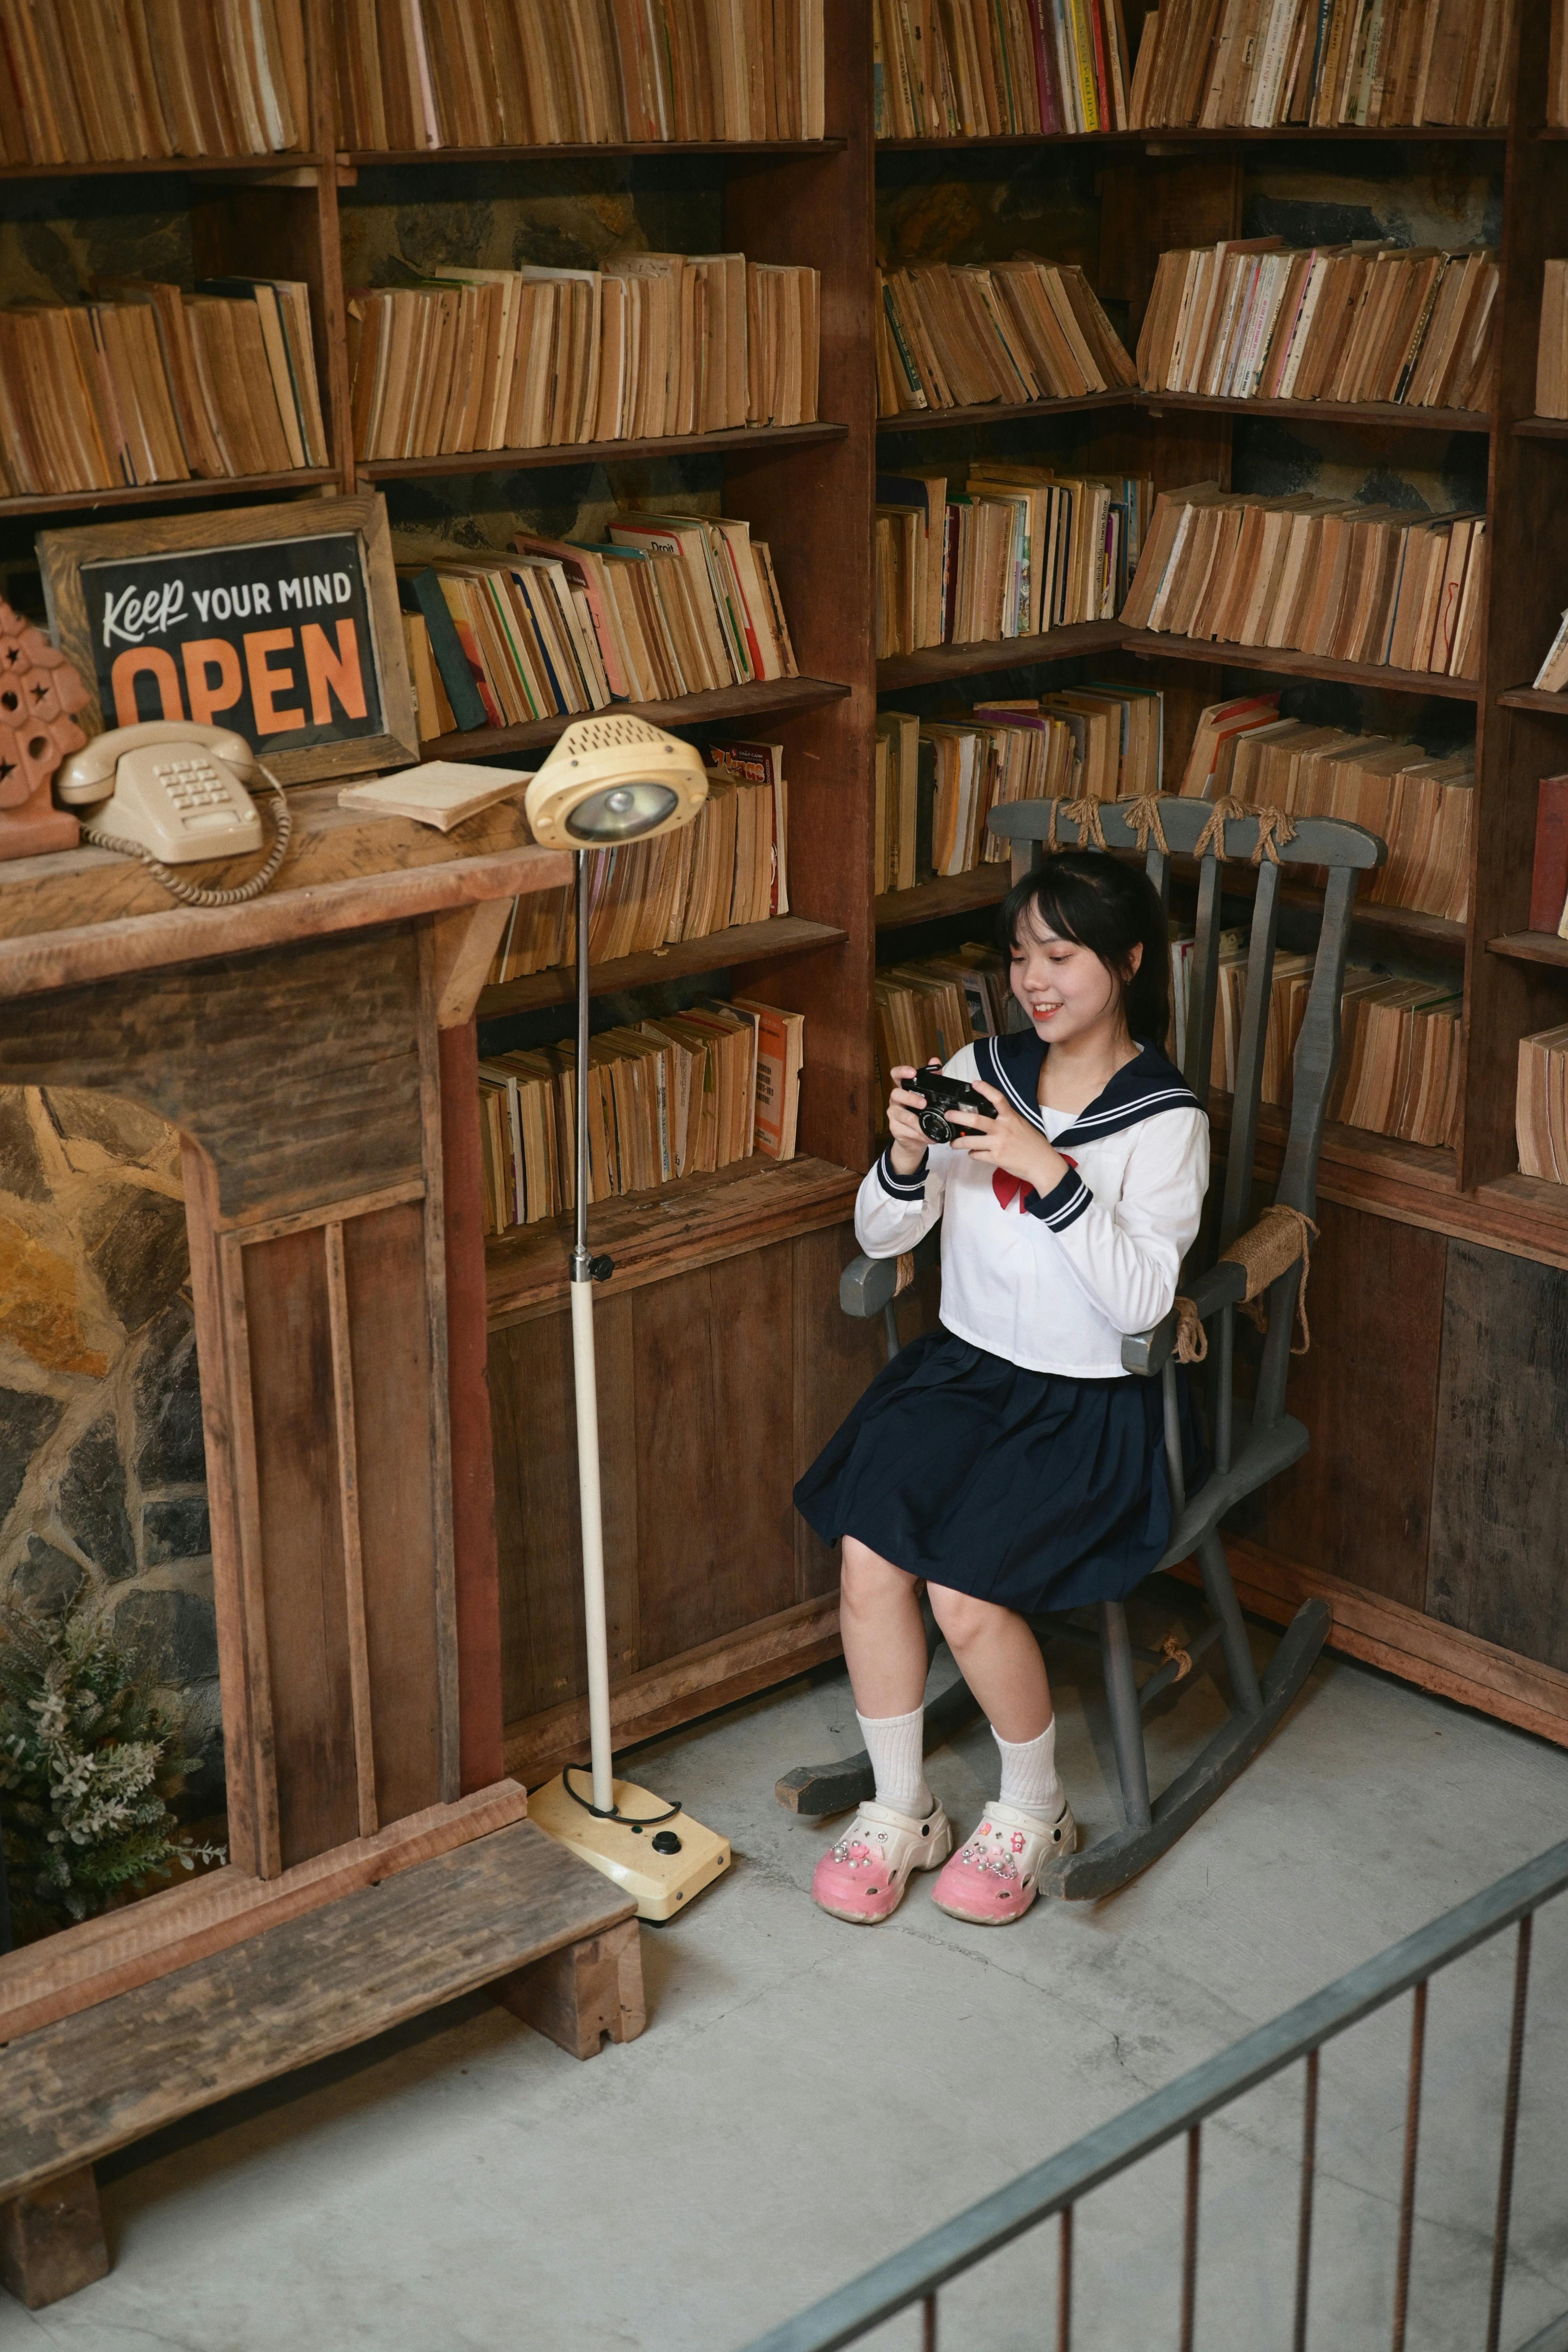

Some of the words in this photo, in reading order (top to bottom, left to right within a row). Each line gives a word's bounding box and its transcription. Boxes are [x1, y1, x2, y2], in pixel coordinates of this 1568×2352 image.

[651, 541, 674, 552] Droit
[103, 579, 188, 648] Keep
[192, 583, 271, 623] YOUR
[278, 572, 352, 611] MIND
[111, 618, 368, 736] OPEN
